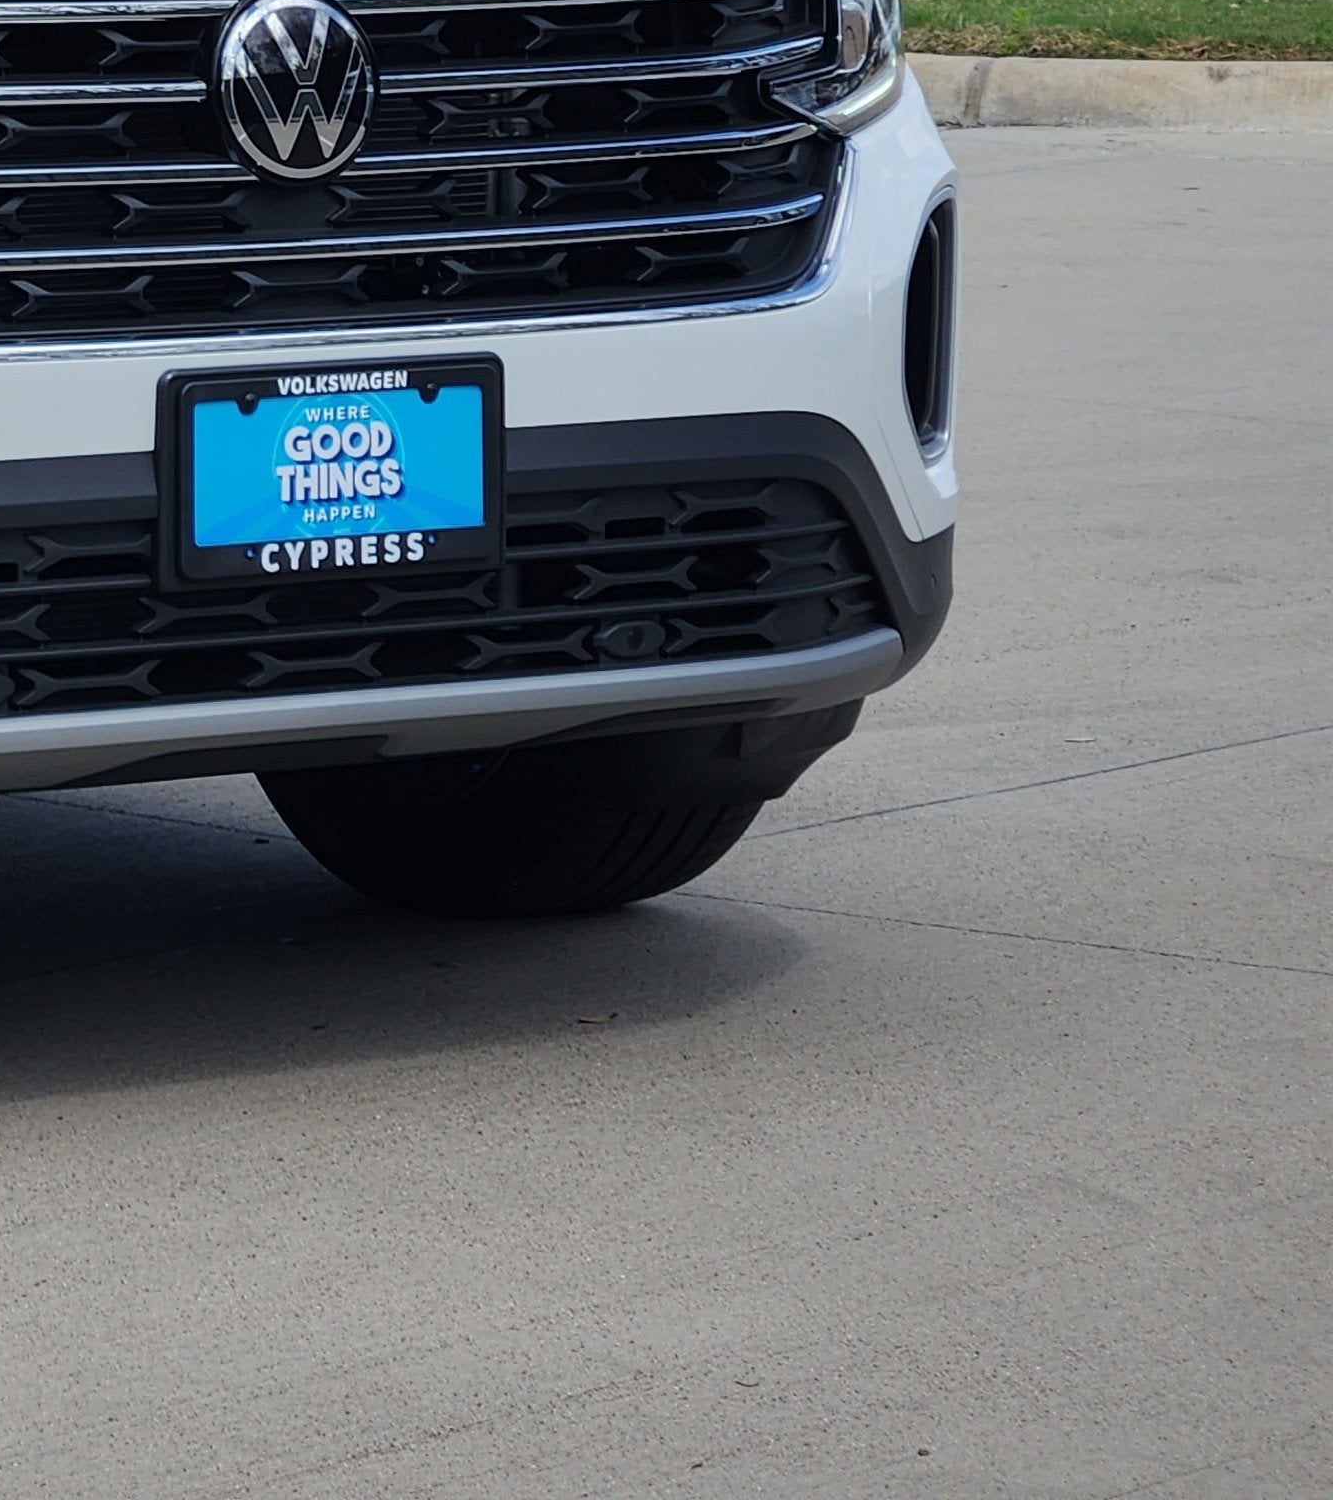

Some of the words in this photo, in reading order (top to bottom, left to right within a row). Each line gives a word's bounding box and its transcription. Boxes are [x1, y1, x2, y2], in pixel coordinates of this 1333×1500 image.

[277, 370, 409, 396] VOLKSWAGEN
[305, 405, 371, 423] WHERE
[284, 421, 394, 462] GOOD
[276, 458, 403, 502] THINGS
[303, 505, 376, 524] HAPPEN
[260, 532, 425, 574] CYPRESS
